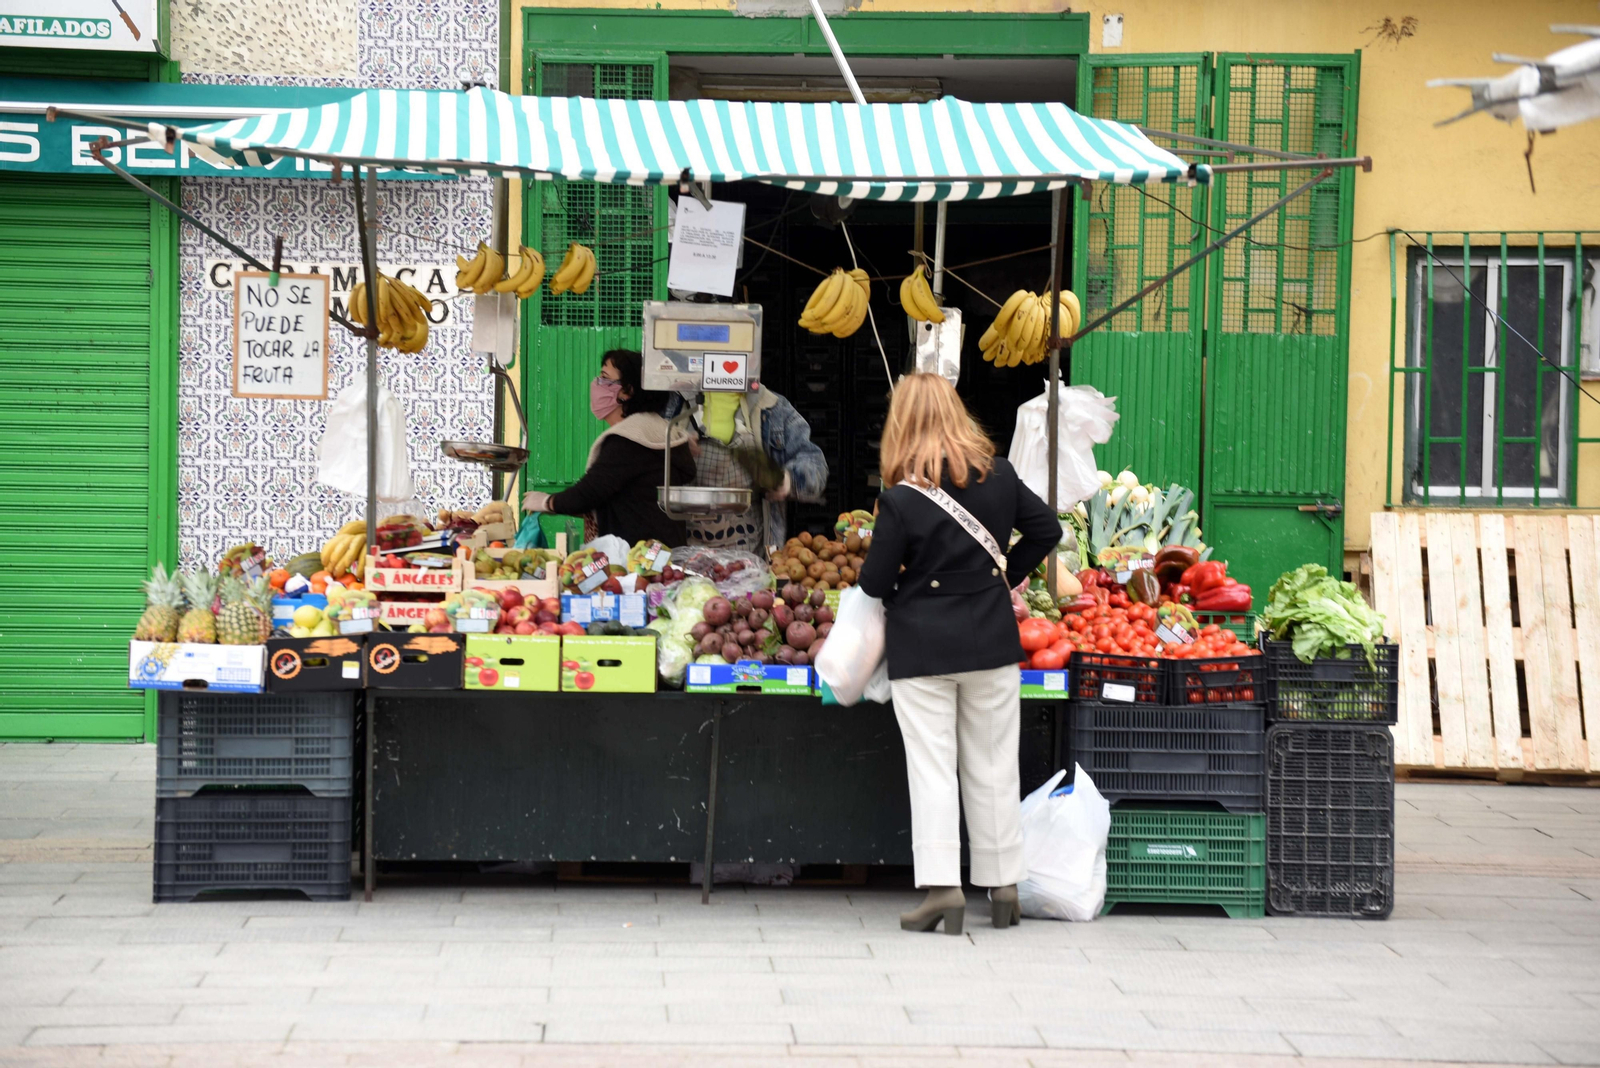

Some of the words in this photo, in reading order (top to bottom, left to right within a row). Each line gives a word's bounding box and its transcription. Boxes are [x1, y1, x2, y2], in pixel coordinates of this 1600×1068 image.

[0, 17, 110, 38] AFILADOS
[247, 283, 279, 307] NO
[287, 284, 311, 304] SE
[241, 311, 304, 334] PUEDE
[243, 340, 294, 359] TOCAR
[303, 340, 320, 358] LA
[243, 366, 294, 385] FRUTA
[711, 360, 715, 373] I
[705, 377, 744, 386] CHURROS
[392, 570, 454, 585] ÁNGELES
